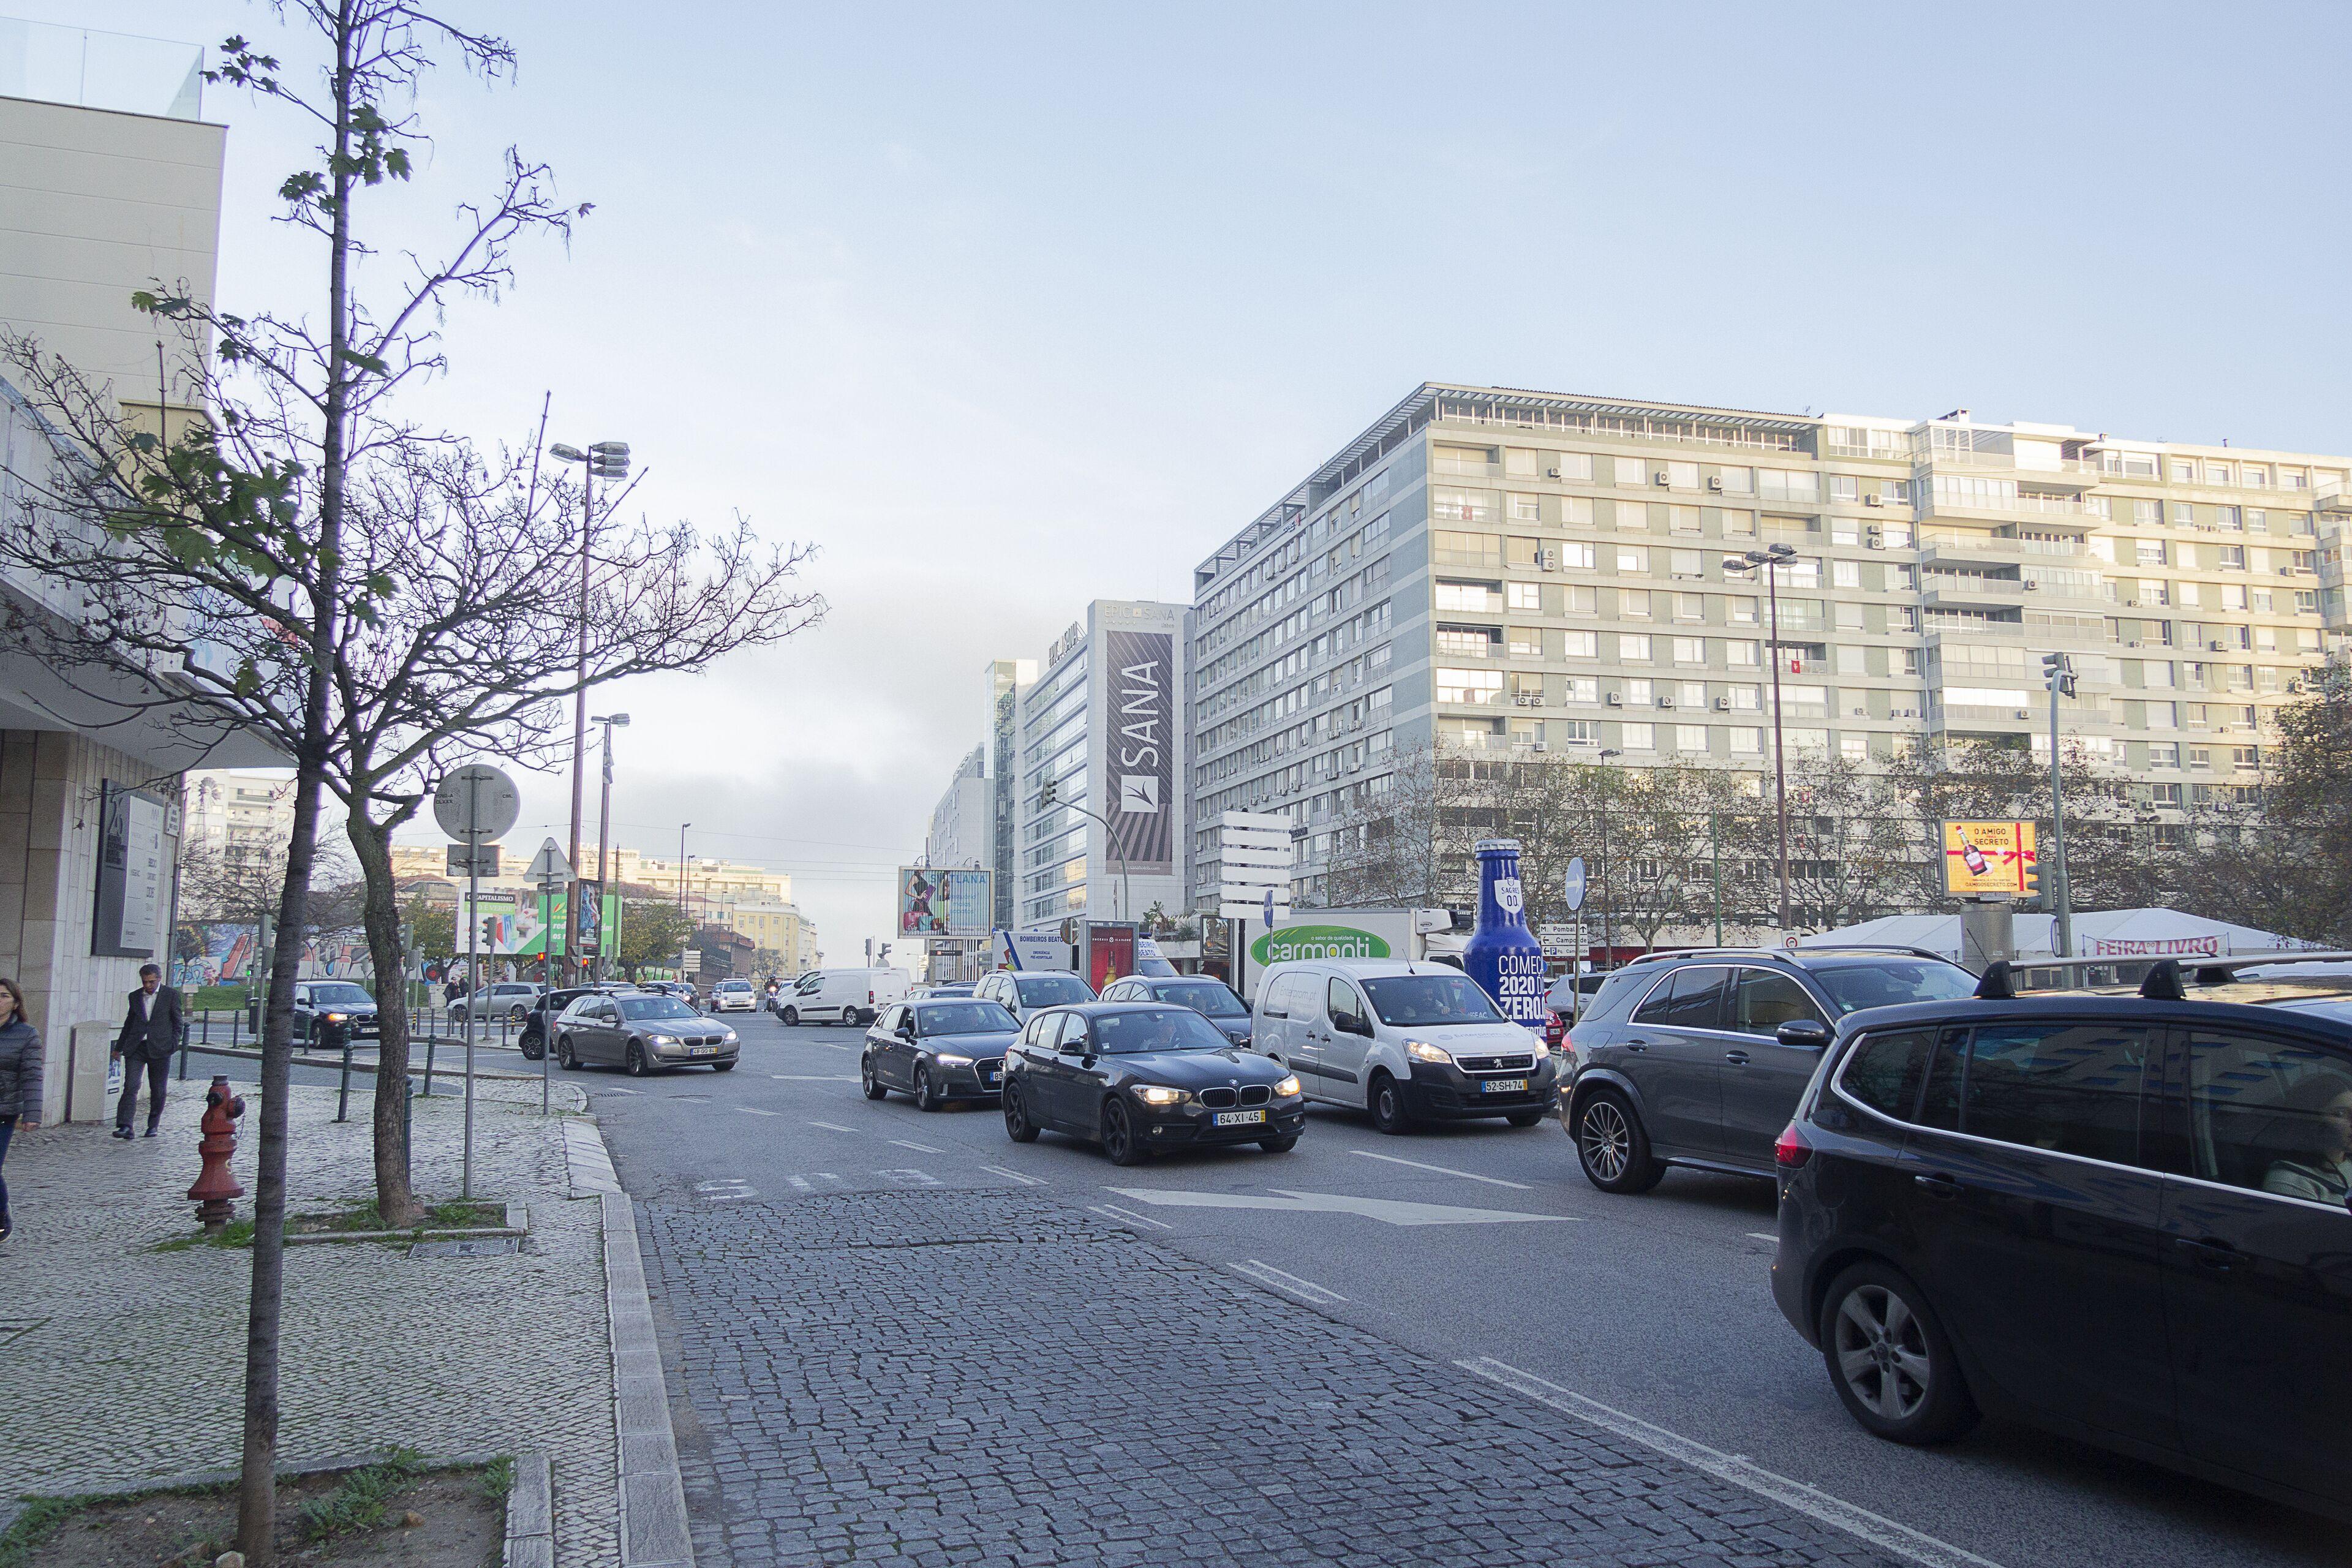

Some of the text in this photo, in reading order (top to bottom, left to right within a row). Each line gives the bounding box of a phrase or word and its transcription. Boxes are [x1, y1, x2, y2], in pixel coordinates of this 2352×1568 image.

[1104, 605, 1175, 621] EPIC SANA
[1121, 660, 1158, 767] SANA
[1267, 937, 1370, 960] carmonti
[2096, 940, 2147, 956] FEIRA
[2155, 936, 2218, 954] LIVRO
[1499, 976, 1535, 995] 2020
